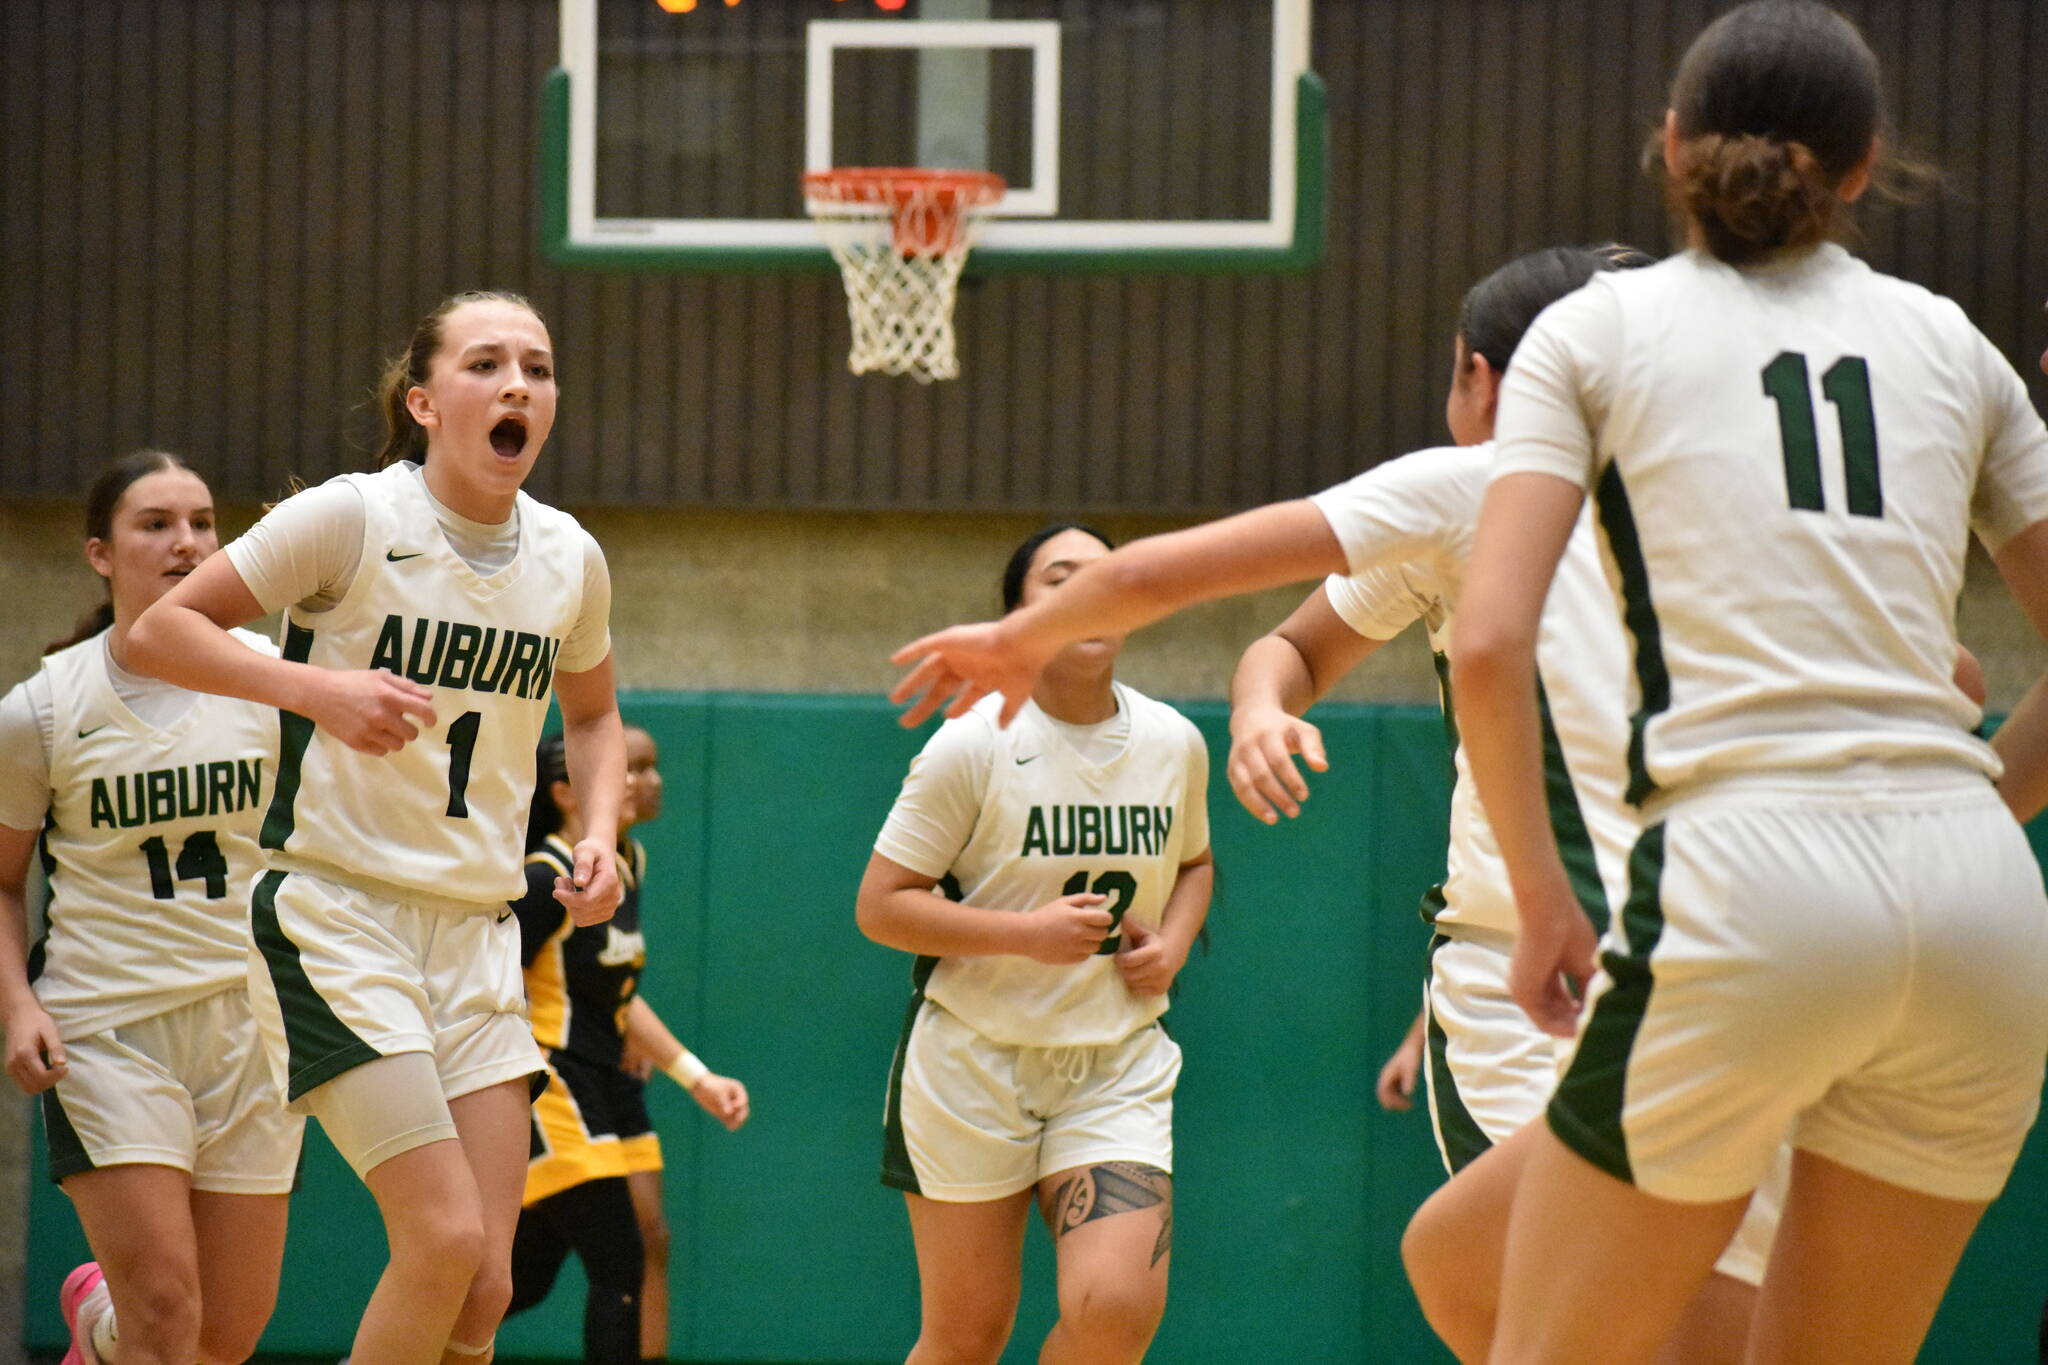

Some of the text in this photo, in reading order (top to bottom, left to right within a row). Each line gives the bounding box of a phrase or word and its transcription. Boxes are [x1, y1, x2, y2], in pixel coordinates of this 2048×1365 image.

[1761, 350, 1884, 518] 11
[370, 614, 560, 700] AUBURN
[92, 758, 263, 829] AUBURN
[446, 711, 481, 818] 1
[139, 830, 228, 899] 14
[1021, 805, 1172, 856] AUBURN
